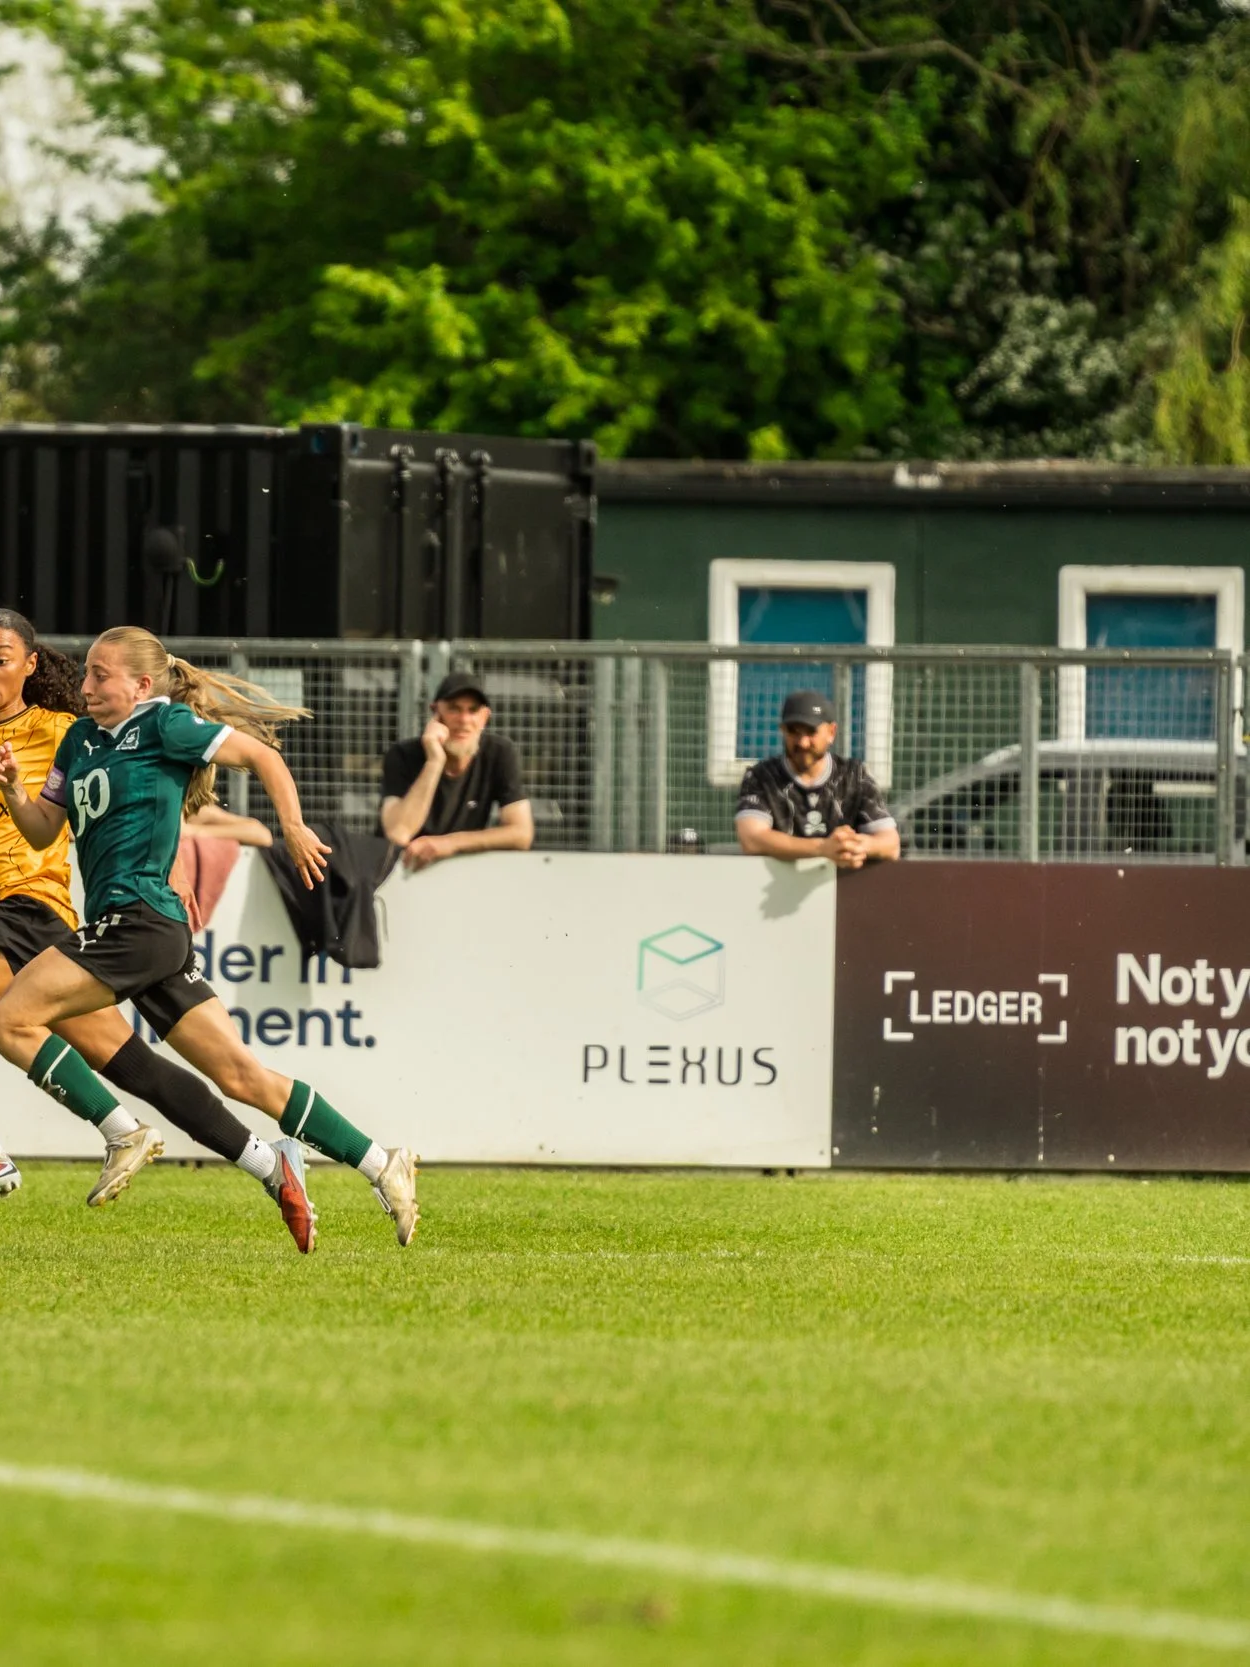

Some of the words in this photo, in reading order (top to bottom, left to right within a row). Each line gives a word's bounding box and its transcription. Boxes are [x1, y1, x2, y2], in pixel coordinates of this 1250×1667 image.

[1116, 952, 1216, 1006] Not
[909, 990, 1043, 1024] LEDGER
[582, 1044, 778, 1086] PLEXUS
[1114, 1018, 1202, 1067] not
